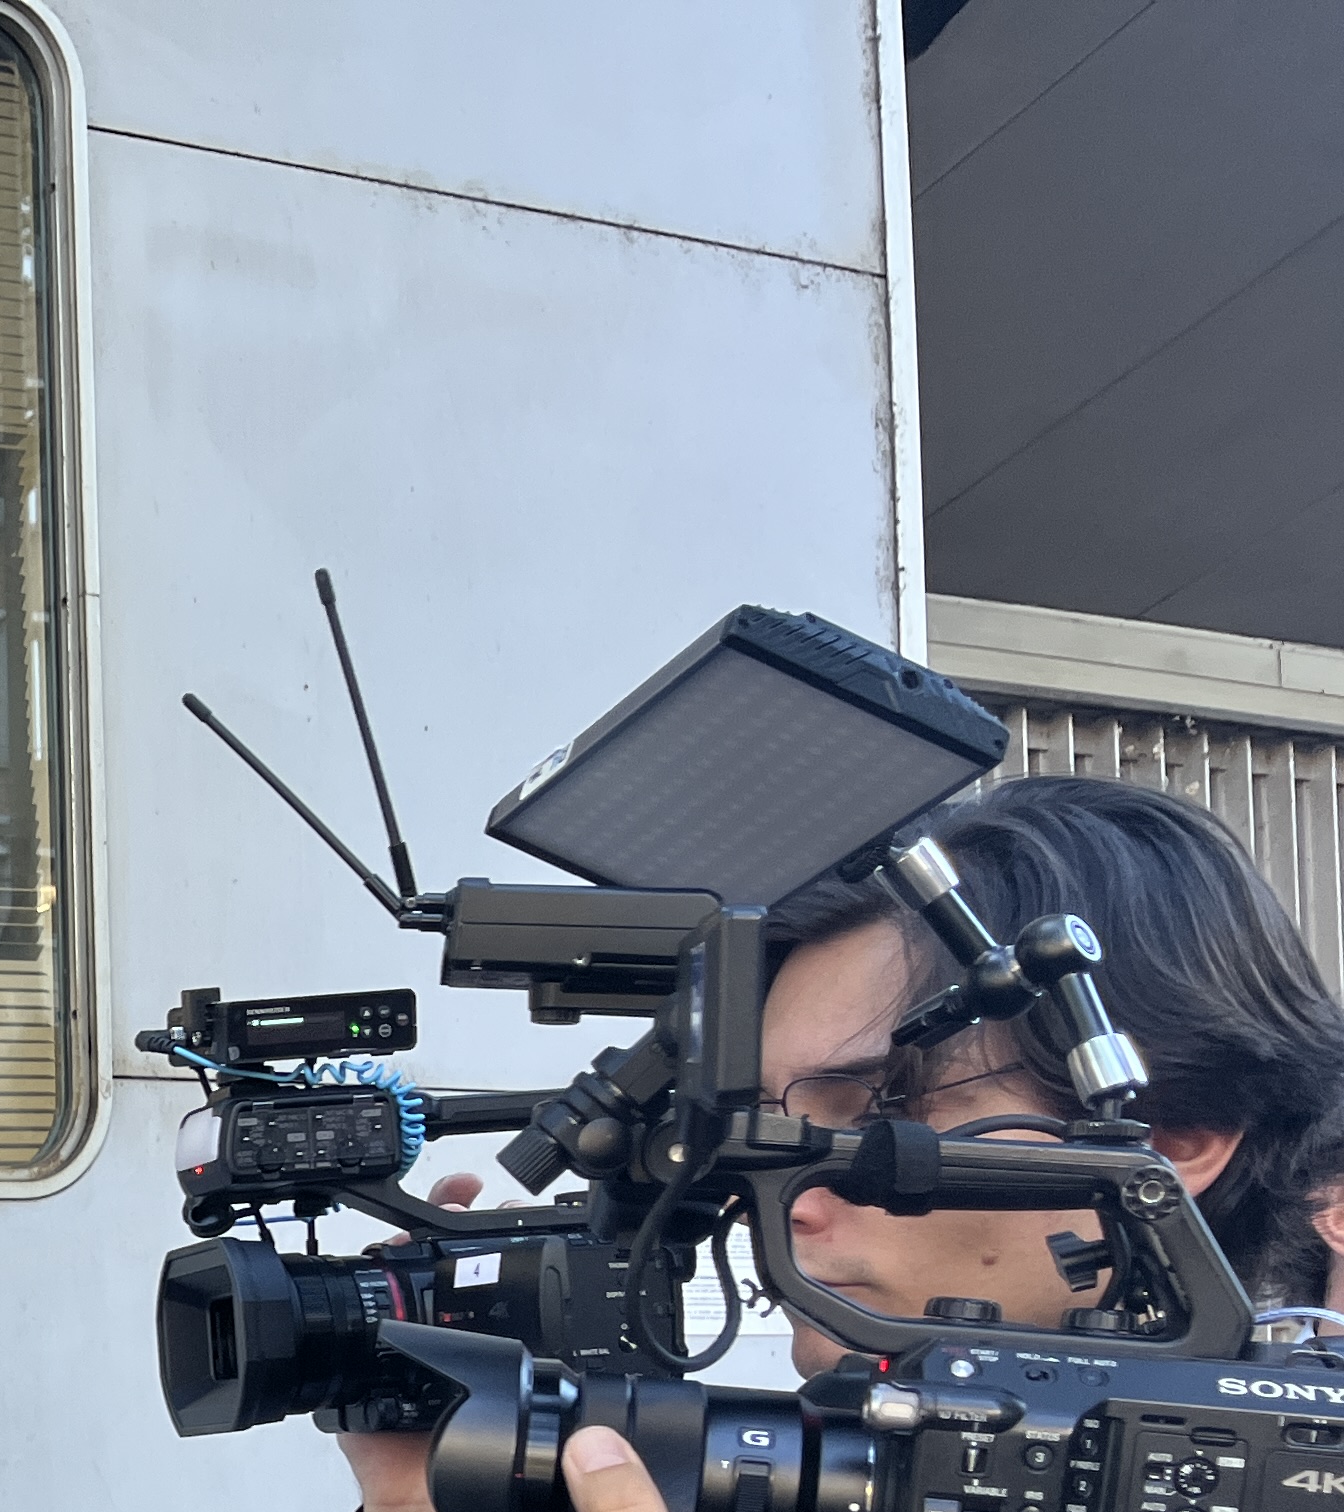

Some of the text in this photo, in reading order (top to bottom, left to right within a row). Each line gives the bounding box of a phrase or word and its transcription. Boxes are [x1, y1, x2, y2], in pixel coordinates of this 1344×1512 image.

[1218, 1377, 1344, 1404] SONY
[742, 1430, 770, 1446] G
[1034, 1452, 1046, 1462] 3
[1078, 1481, 1087, 1491] 2
[1281, 1469, 1344, 1494] 4K
